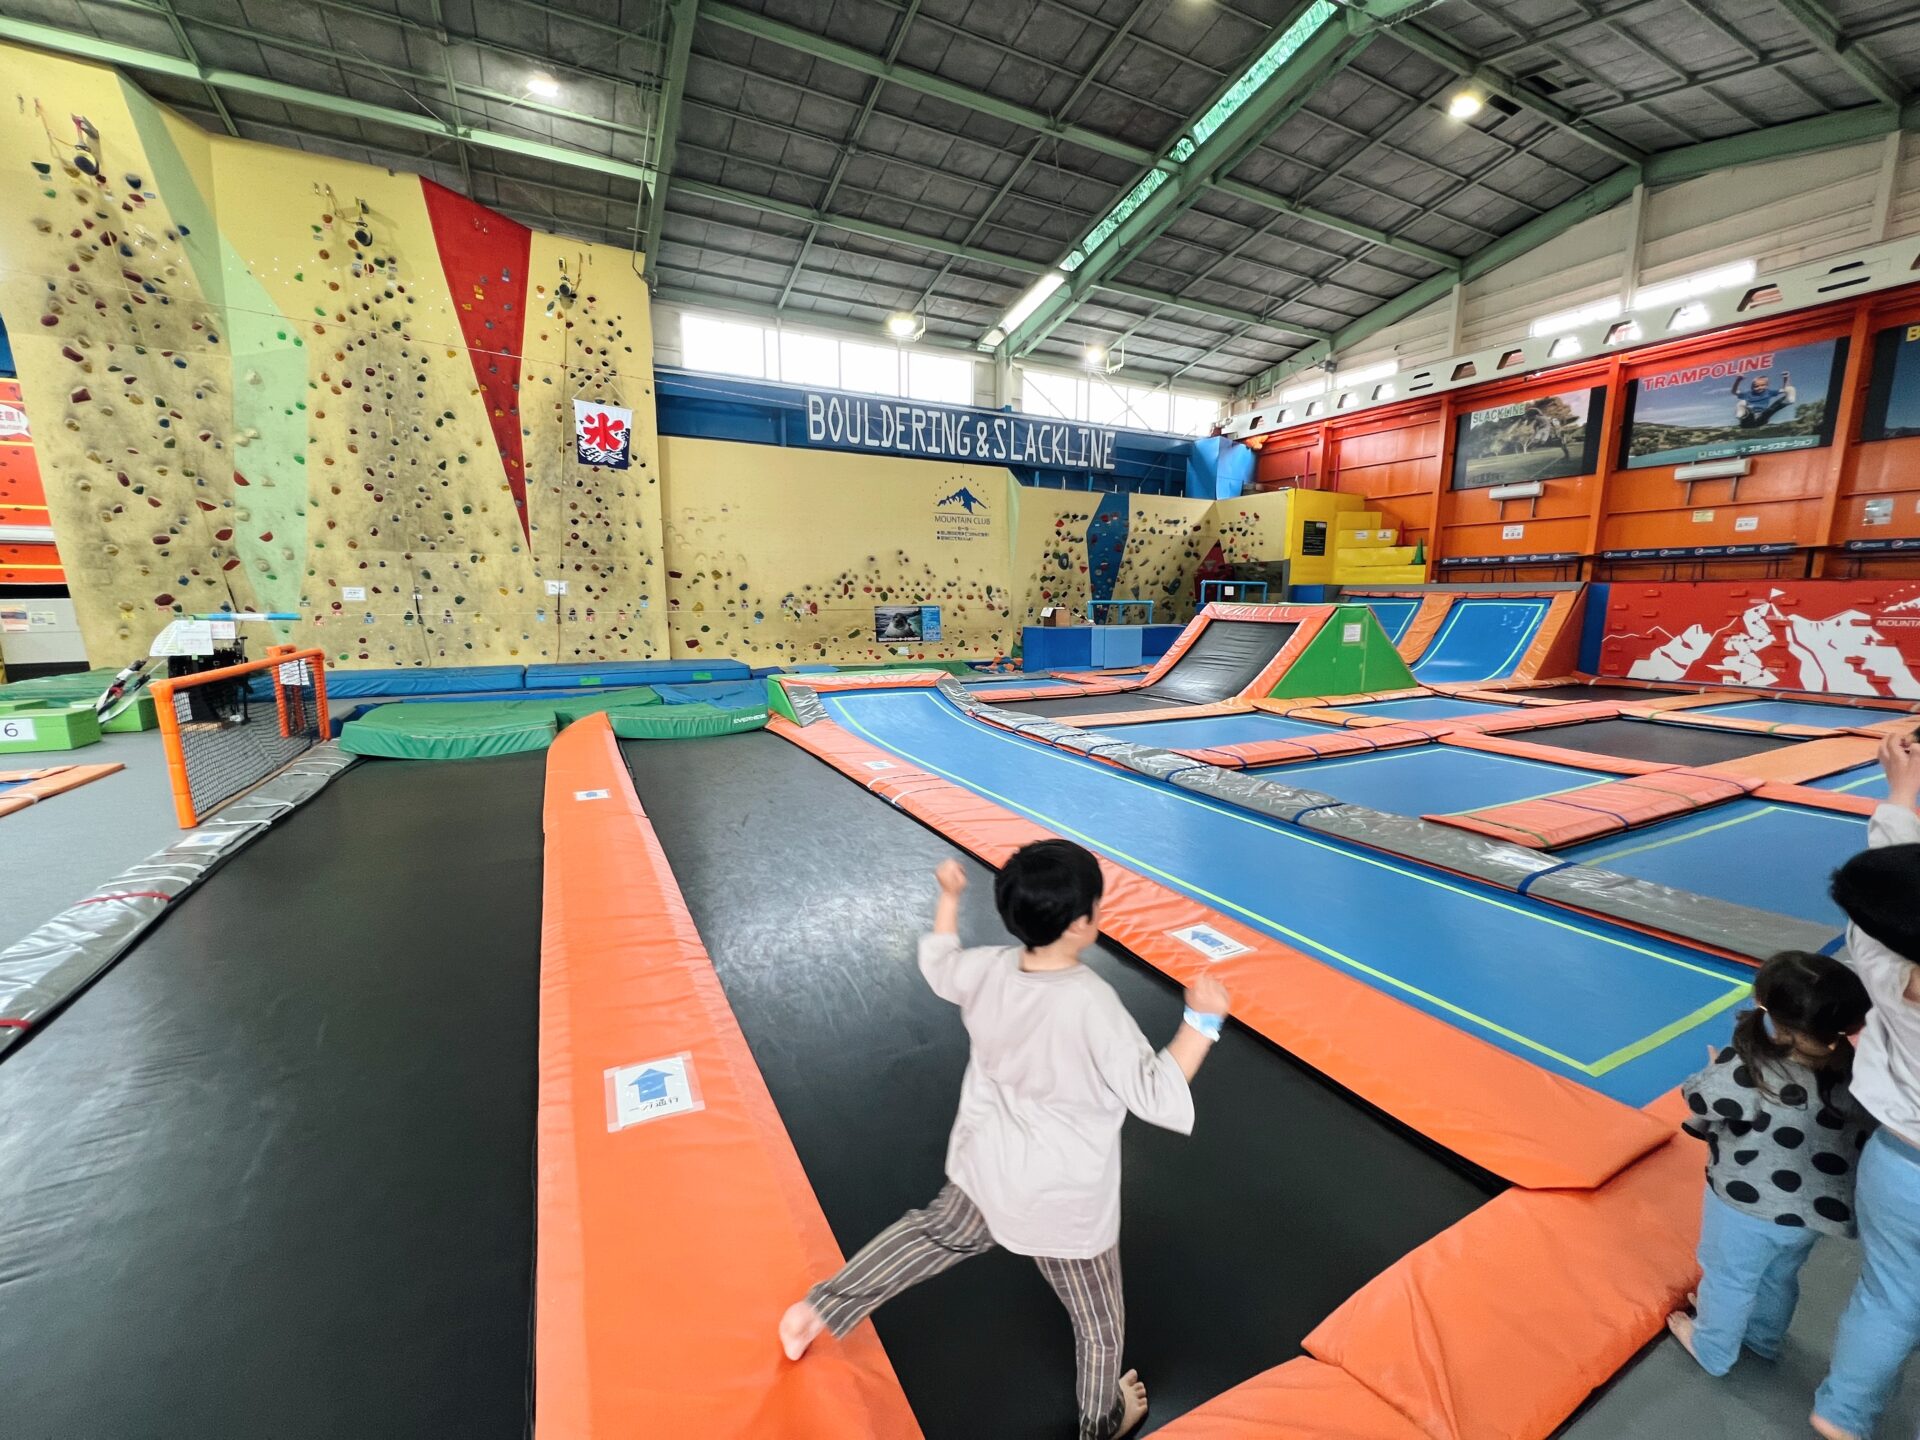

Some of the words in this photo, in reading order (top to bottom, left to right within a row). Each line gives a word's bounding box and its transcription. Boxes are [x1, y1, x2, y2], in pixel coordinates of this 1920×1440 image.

[1643, 353, 1775, 392] TRAMPOLINE
[1472, 404, 1526, 424] SLACKLINE
[583, 412, 624, 451] 氷
[934, 515, 972, 524] MOUNTAIN
[973, 517, 991, 525] CLUB
[4, 722, 19, 738] 6
